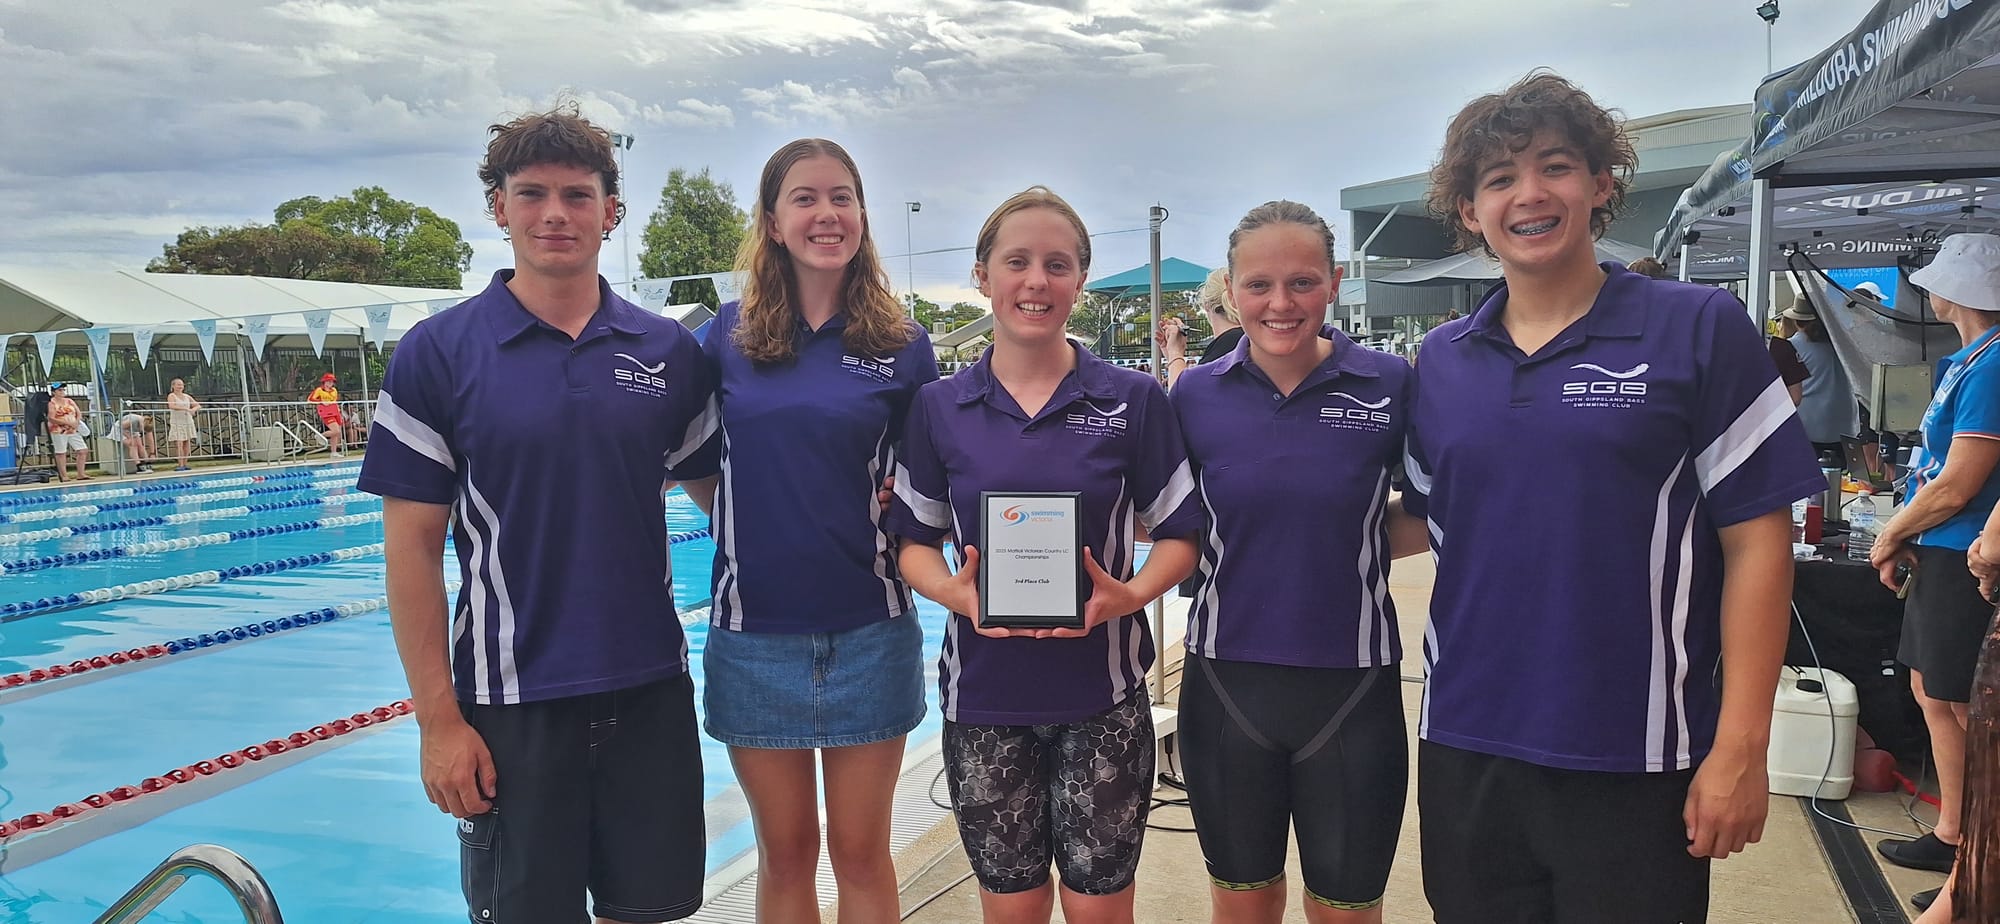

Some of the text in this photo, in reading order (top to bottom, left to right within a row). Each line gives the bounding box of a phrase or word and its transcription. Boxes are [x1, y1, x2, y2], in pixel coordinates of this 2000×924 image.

[841, 355, 894, 377] SGB
[614, 368, 666, 389] SGB
[1562, 381, 1647, 395] SGB
[1066, 413, 1127, 429] SGB
[1319, 407, 1391, 424] SGB
